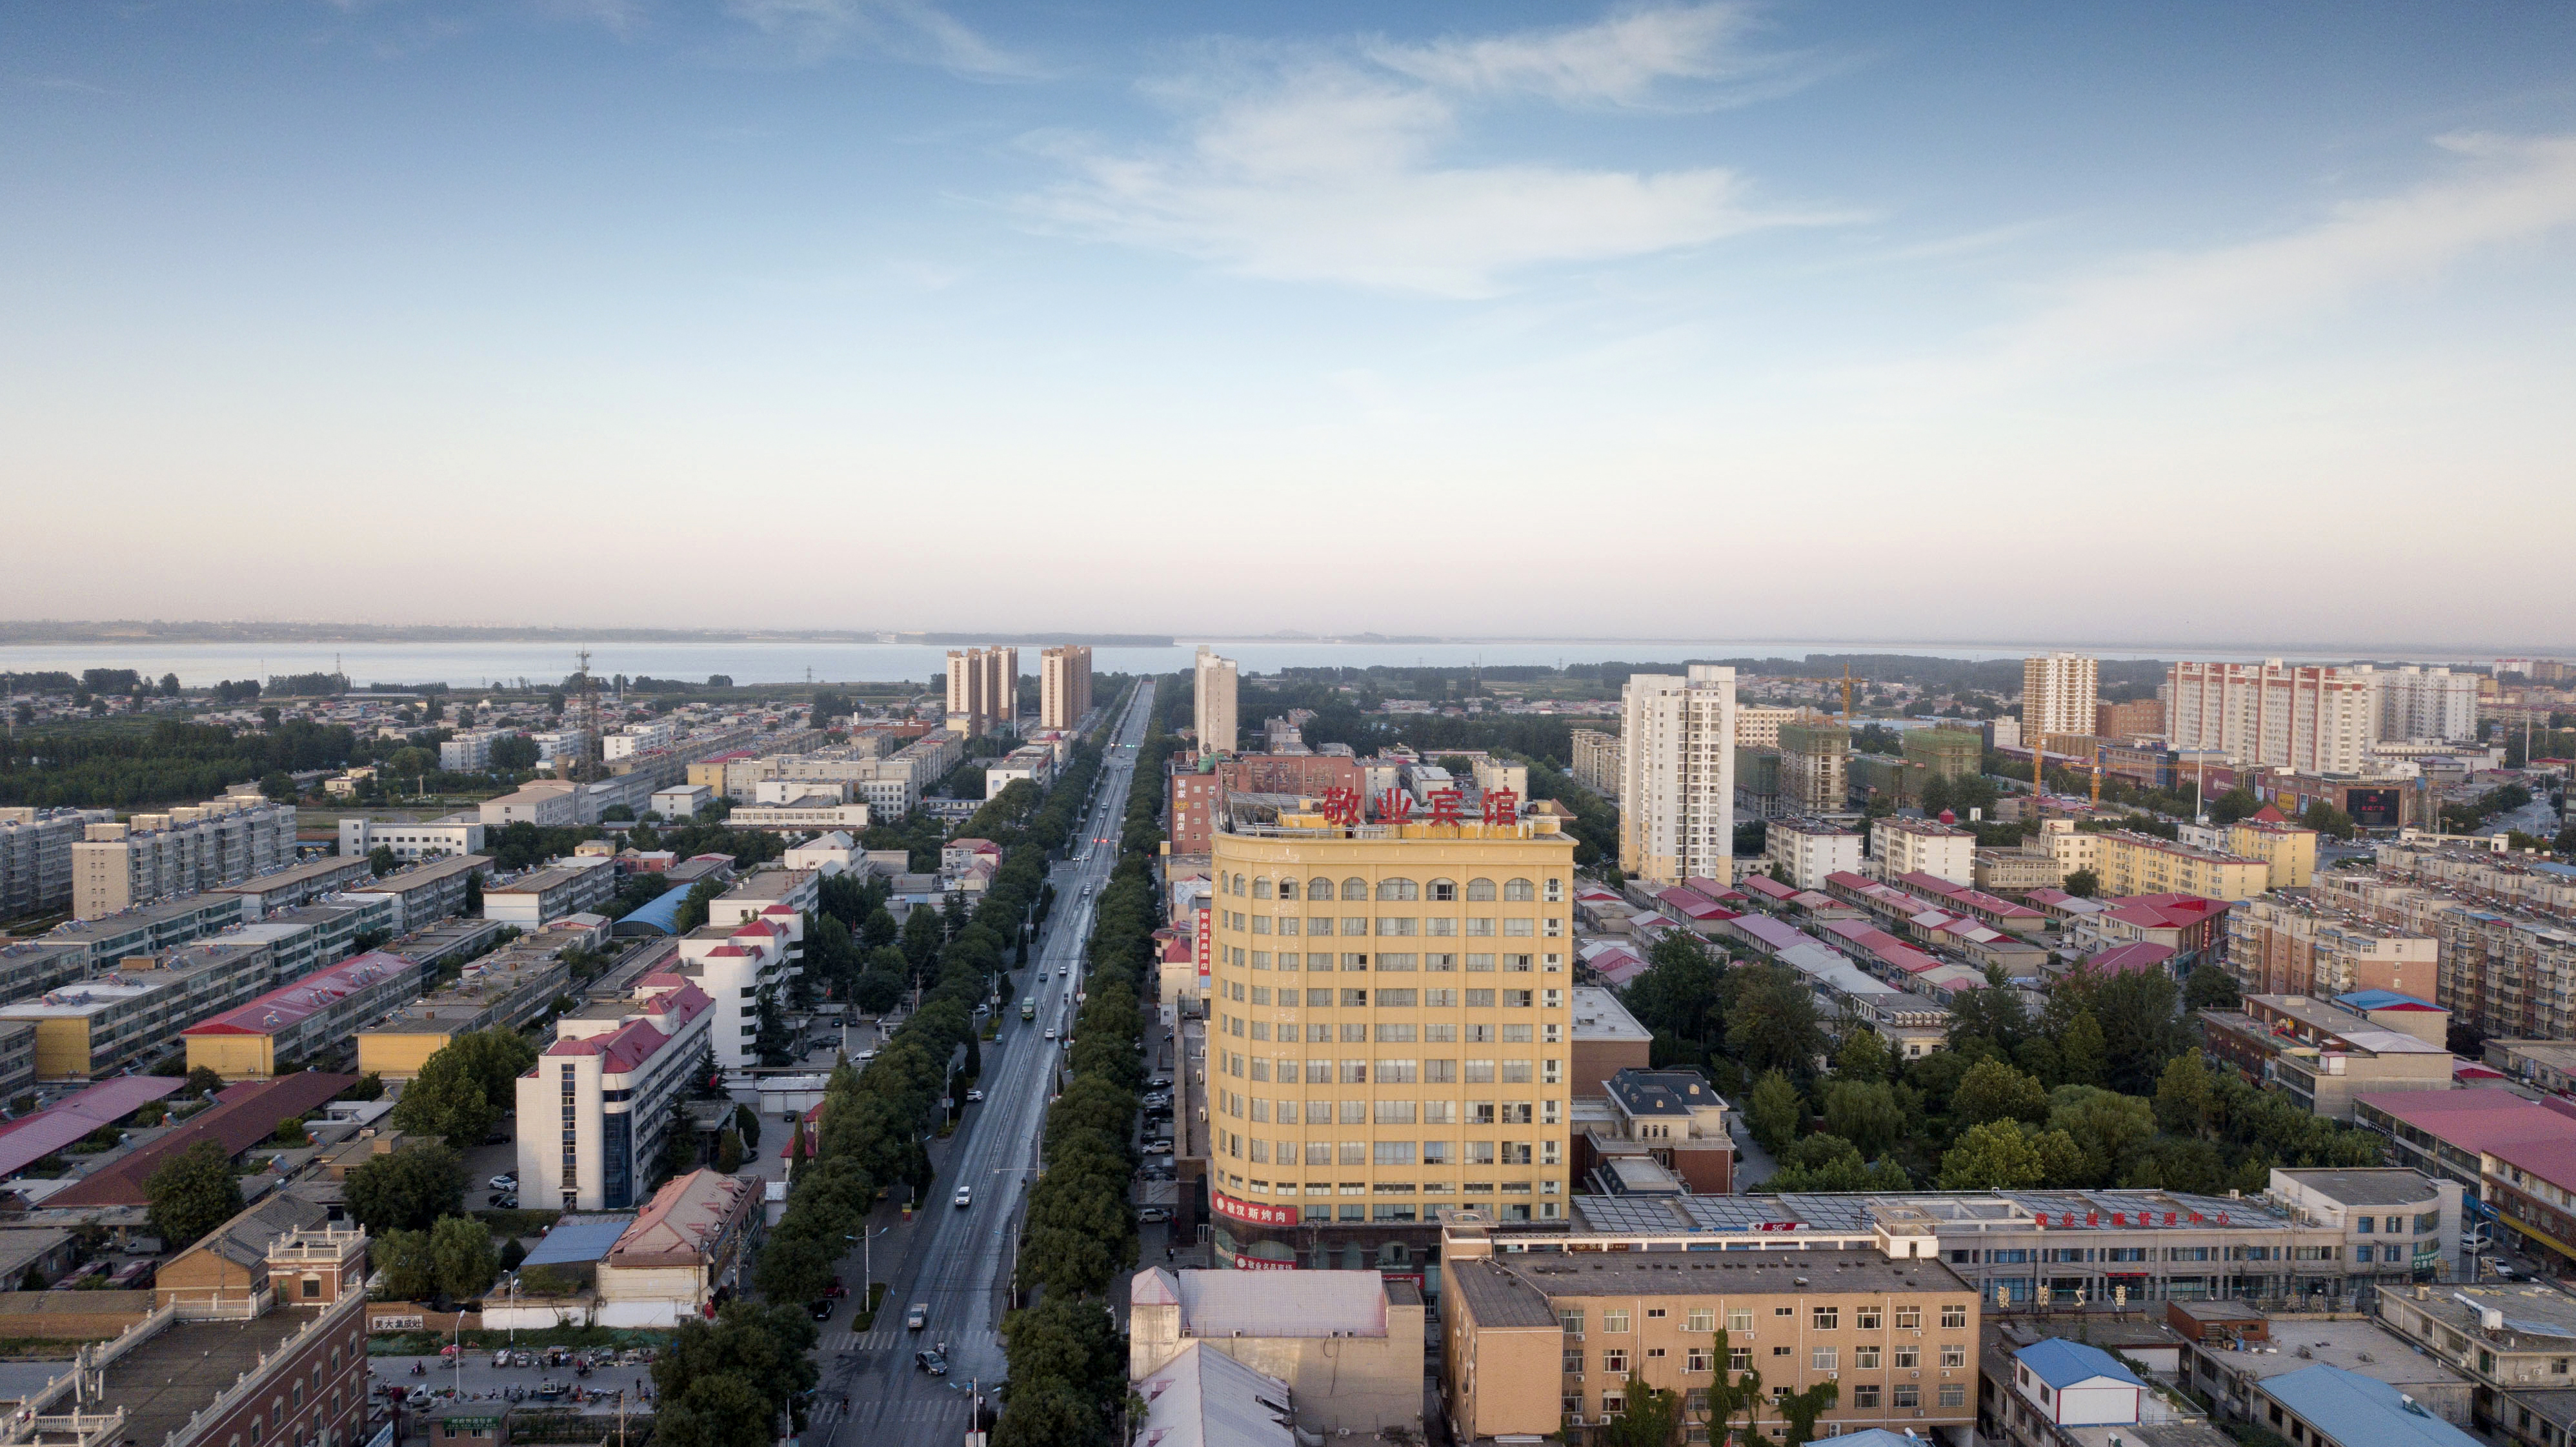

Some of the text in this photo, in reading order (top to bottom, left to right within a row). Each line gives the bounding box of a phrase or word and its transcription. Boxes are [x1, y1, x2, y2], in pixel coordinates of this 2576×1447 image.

[1323, 787, 1518, 827] 敬业宾馆
[2035, 1211, 2229, 1226] 敬业健康管理中心
